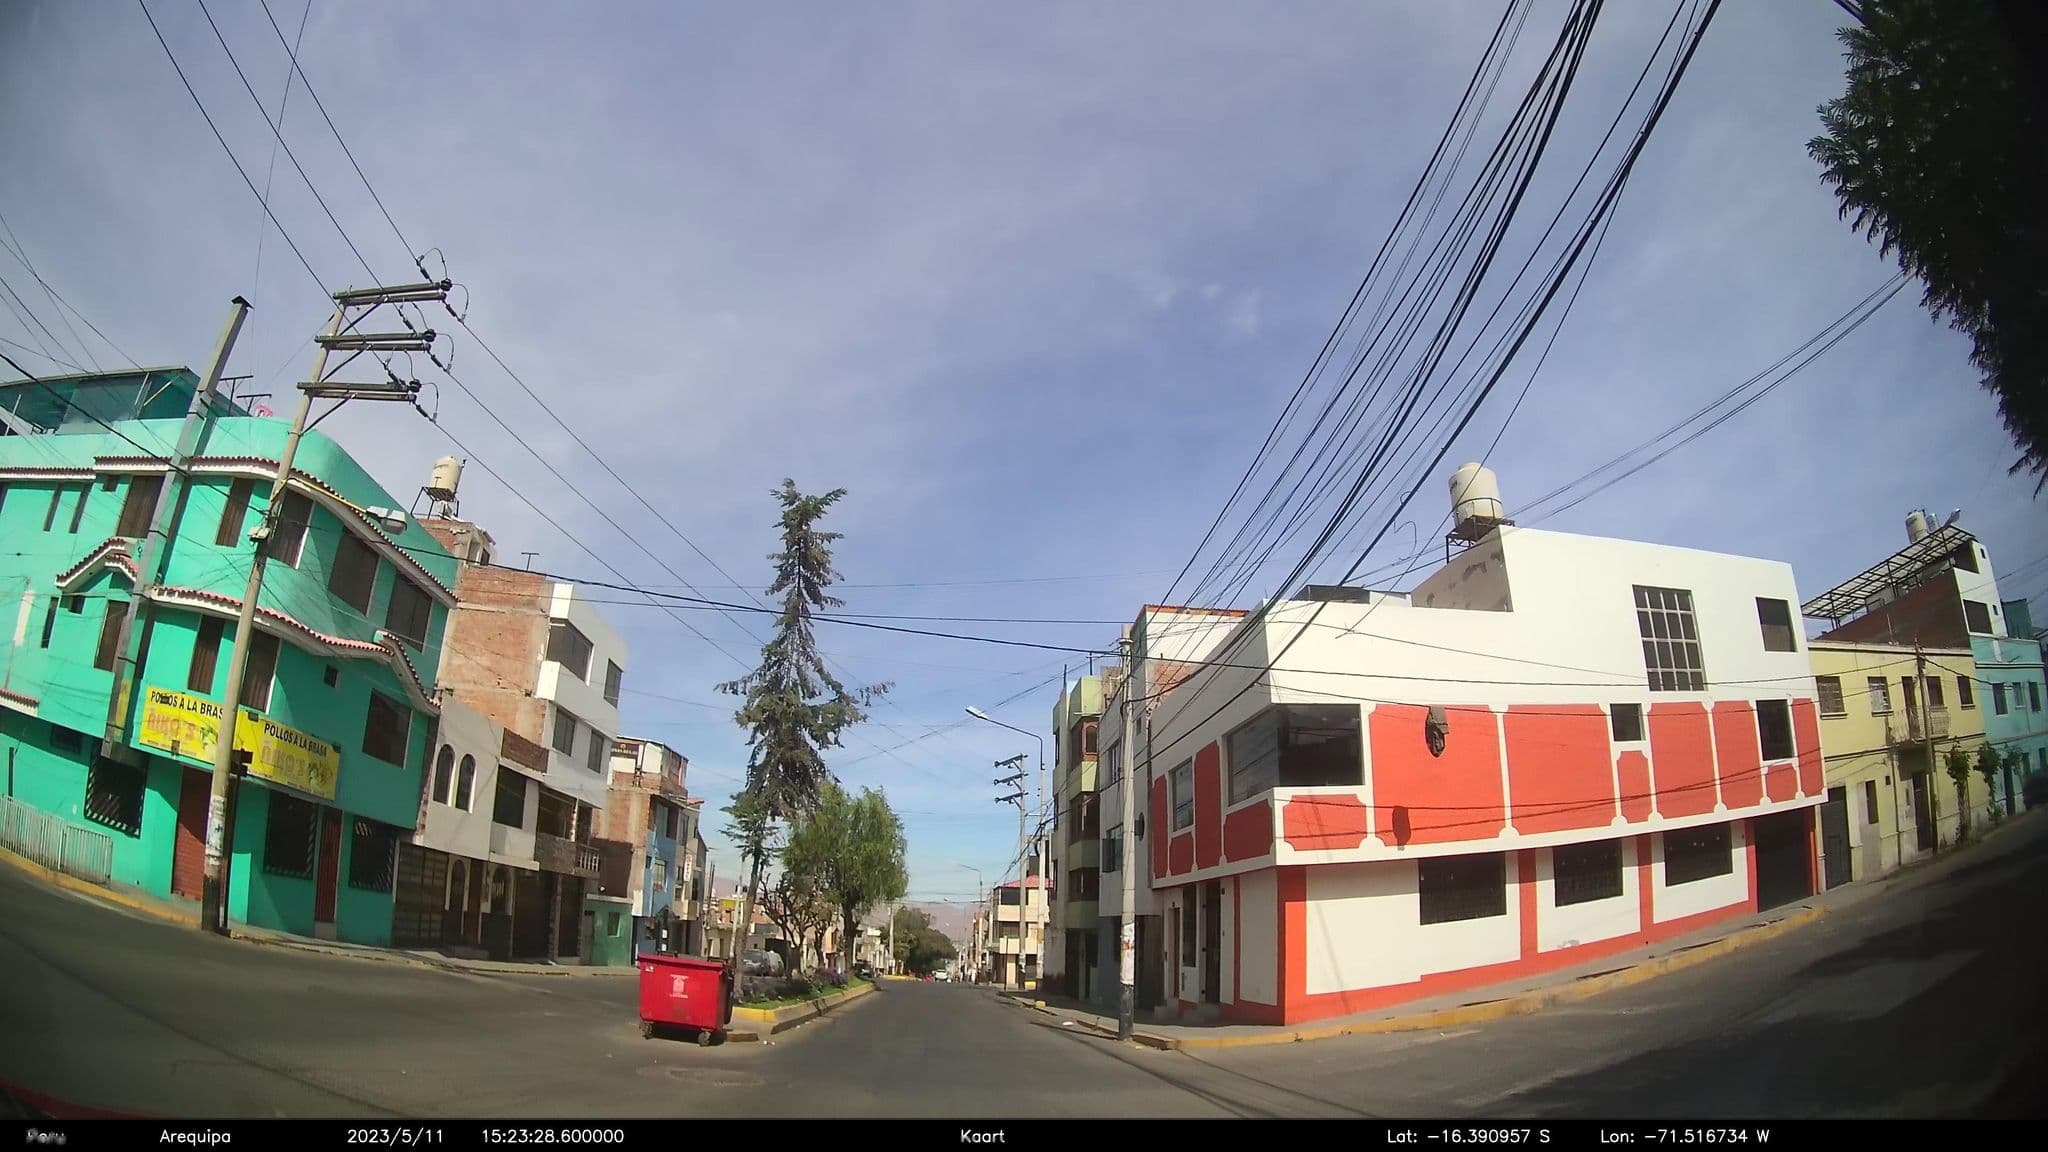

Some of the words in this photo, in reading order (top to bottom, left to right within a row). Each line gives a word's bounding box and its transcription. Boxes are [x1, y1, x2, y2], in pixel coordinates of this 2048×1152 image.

[151, 690, 178, 707] POOS
[178, 697, 185, 709] A
[187, 699, 198, 713] LA
[200, 703, 223, 719] BRAS
[264, 723, 292, 743] POLLOS
[299, 737, 307, 751] LA
